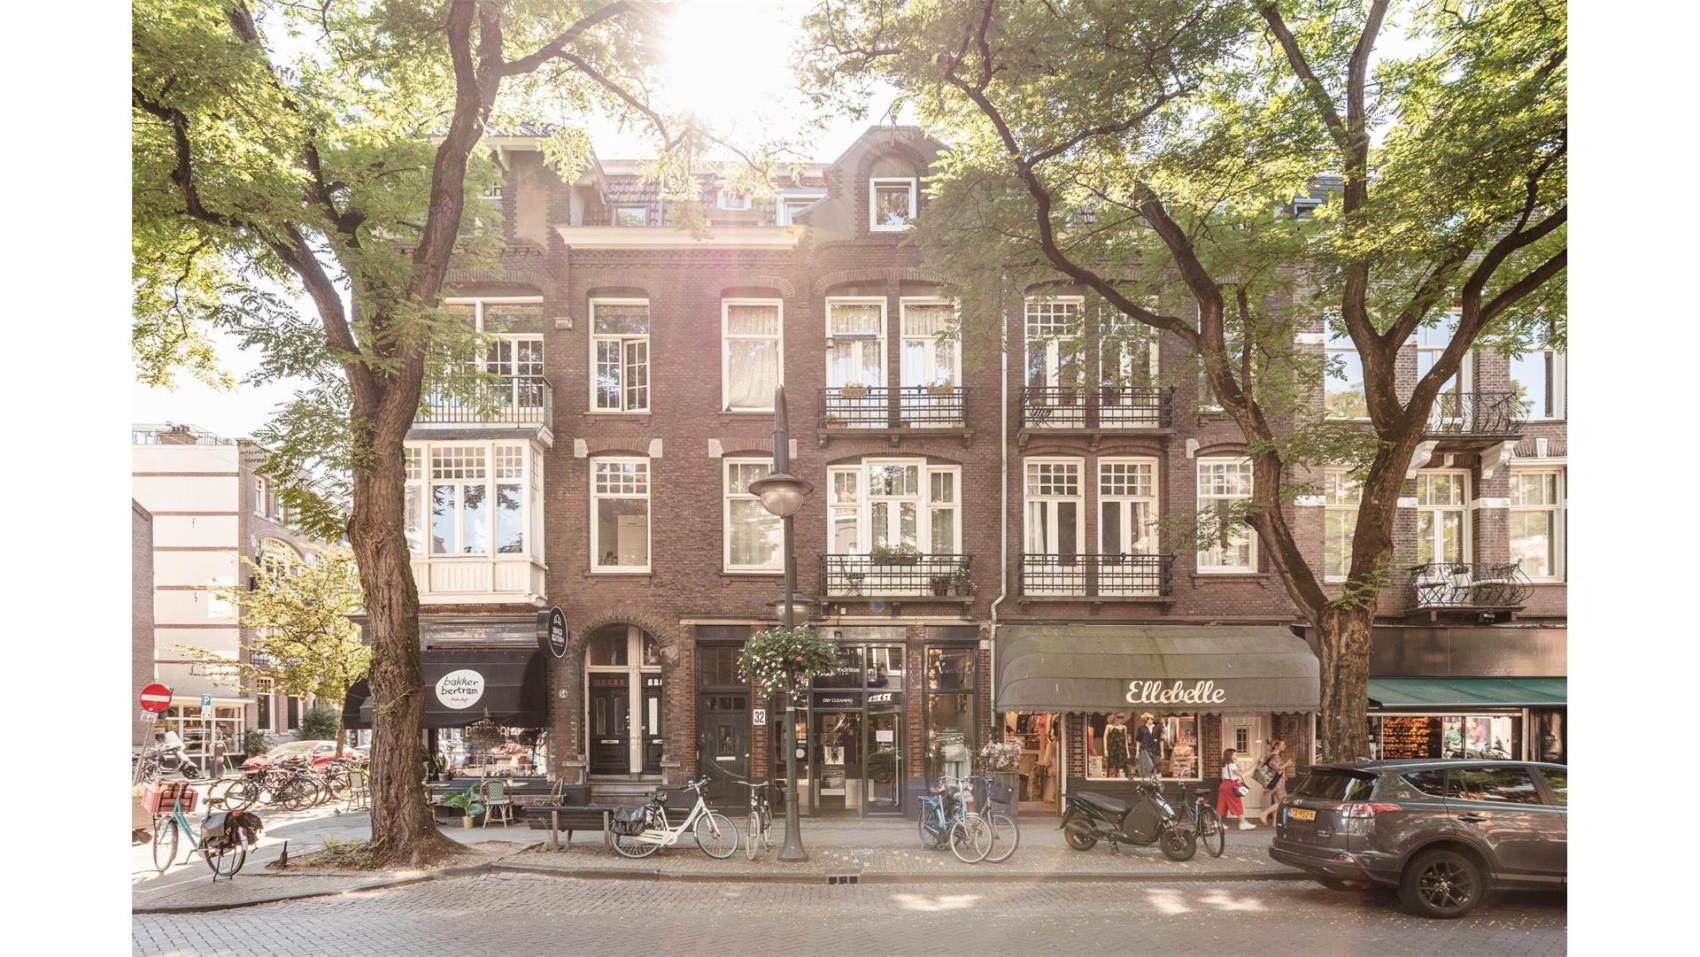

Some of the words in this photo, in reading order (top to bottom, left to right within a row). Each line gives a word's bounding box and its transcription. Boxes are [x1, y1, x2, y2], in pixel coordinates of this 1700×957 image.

[443, 676, 479, 687] bakker
[441, 686, 478, 695] bertram
[1125, 680, 1227, 704] Ellebelle
[754, 710, 765, 723] 32
